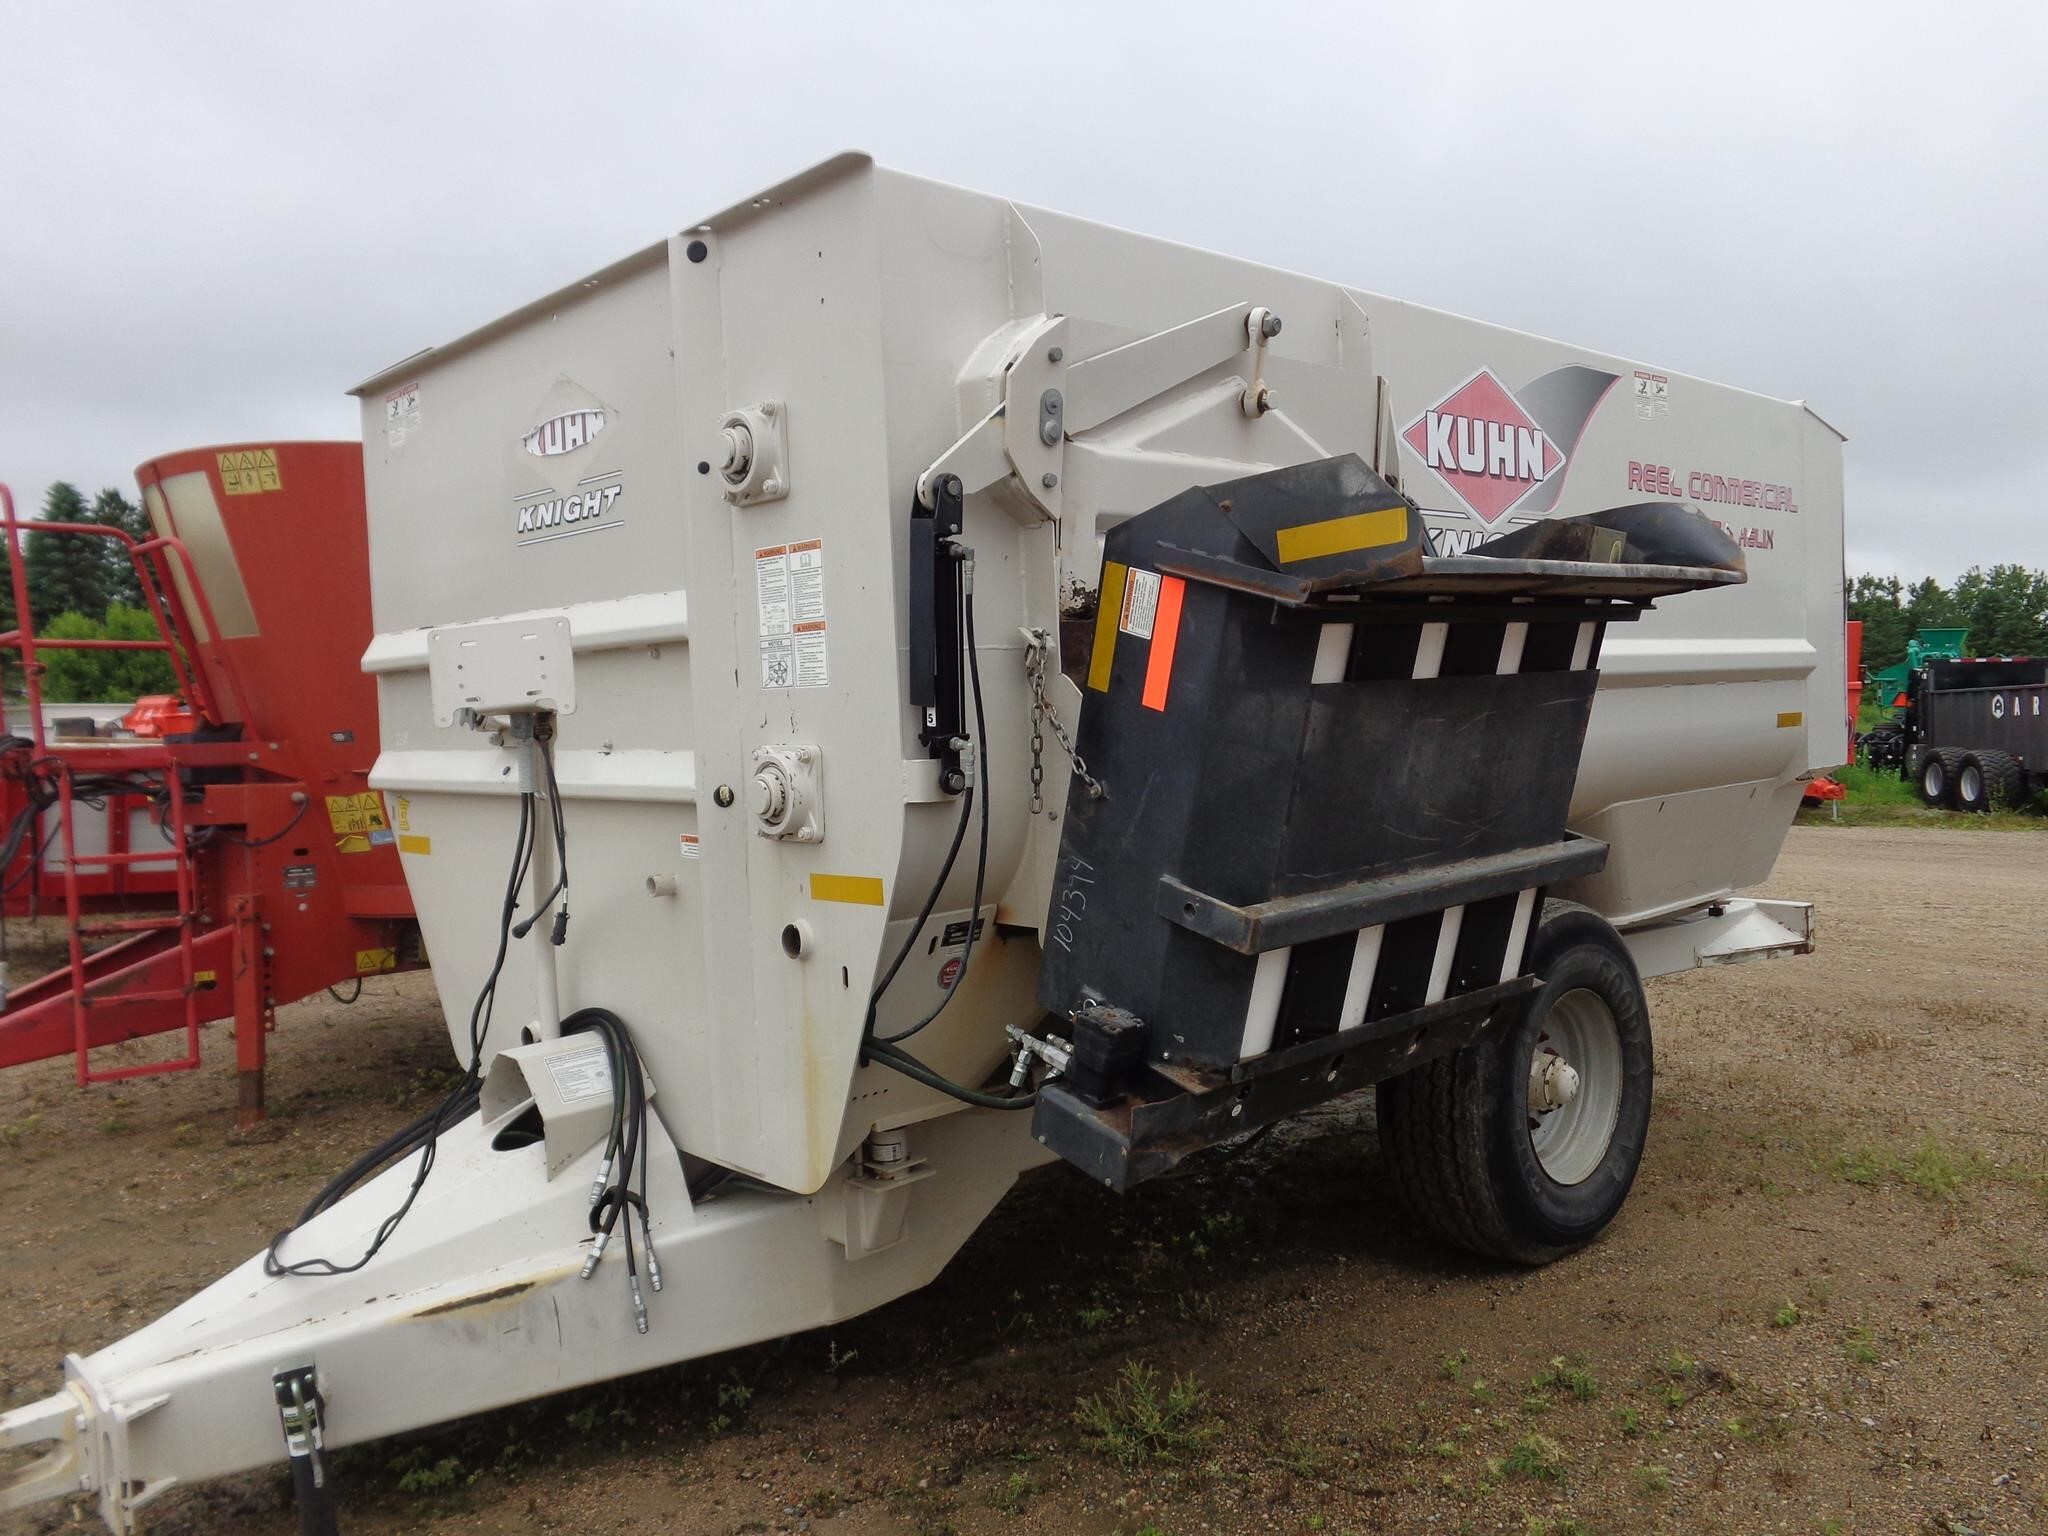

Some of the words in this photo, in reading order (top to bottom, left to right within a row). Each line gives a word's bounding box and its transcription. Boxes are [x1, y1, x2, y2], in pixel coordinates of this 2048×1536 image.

[523, 409, 605, 457] KUHN
[1426, 410, 1544, 482] KUHN
[517, 484, 622, 533] KNIGHT
[1628, 461, 1682, 497] REEL
[1688, 471, 1799, 513] COMMERCIAL
[927, 713, 934, 724] 5
